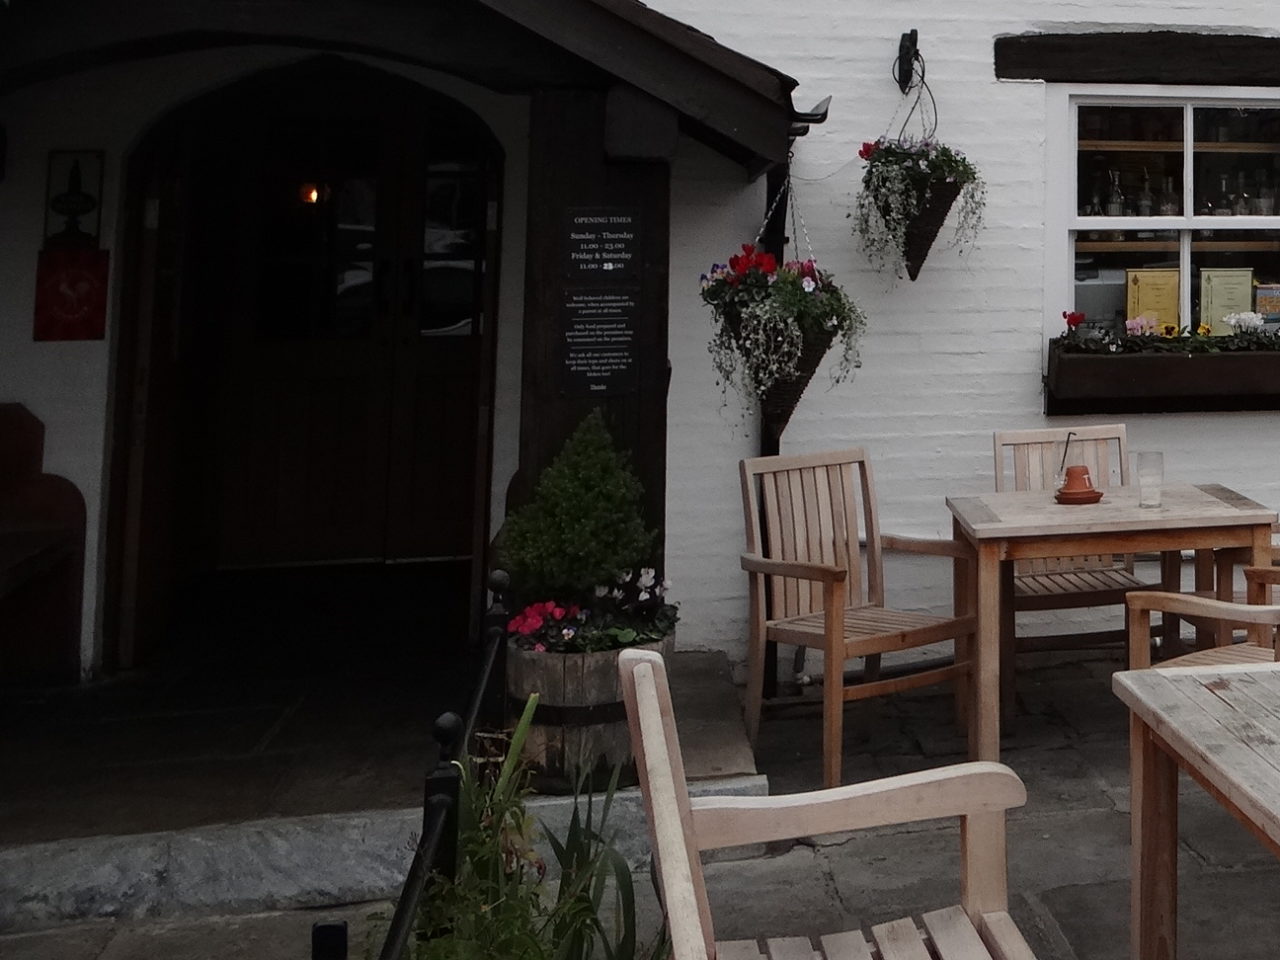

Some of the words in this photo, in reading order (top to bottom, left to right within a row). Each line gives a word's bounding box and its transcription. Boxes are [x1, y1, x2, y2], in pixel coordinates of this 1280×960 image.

[570, 232, 596, 240] Sunday
[602, 231, 634, 240] Thursday
[571, 252, 593, 260] Friday
